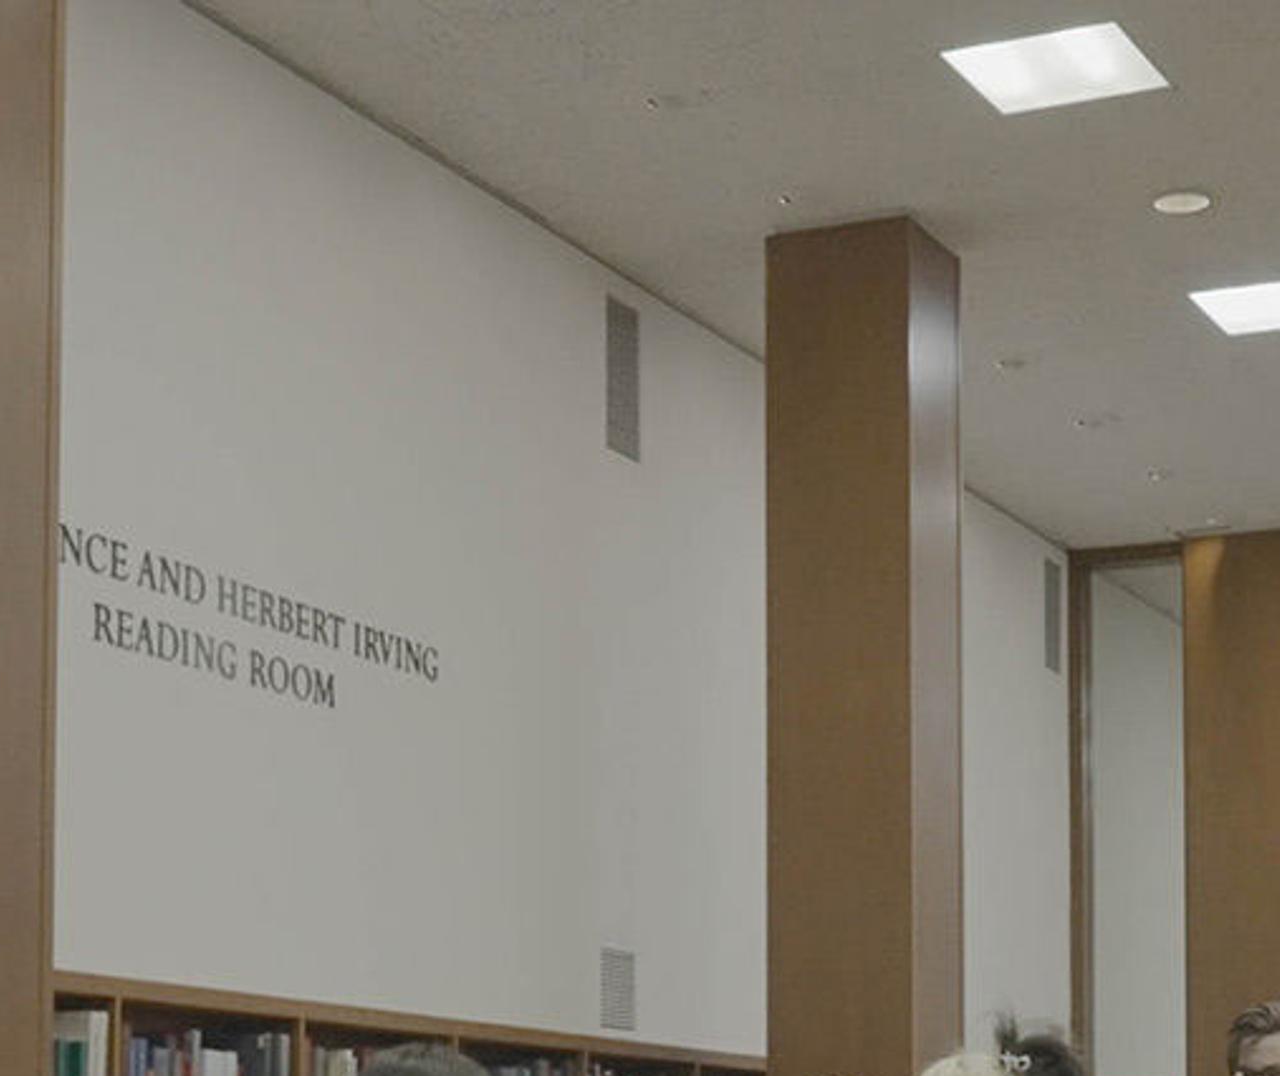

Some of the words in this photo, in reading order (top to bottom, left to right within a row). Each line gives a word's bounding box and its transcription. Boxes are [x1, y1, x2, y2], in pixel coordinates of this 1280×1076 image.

[59, 523, 129, 582] NCE
[137, 552, 206, 604] AND
[218, 576, 346, 649] HERBERT
[354, 622, 439, 683] IRVING
[93, 602, 237, 680] READING
[250, 649, 336, 709] ROOM
